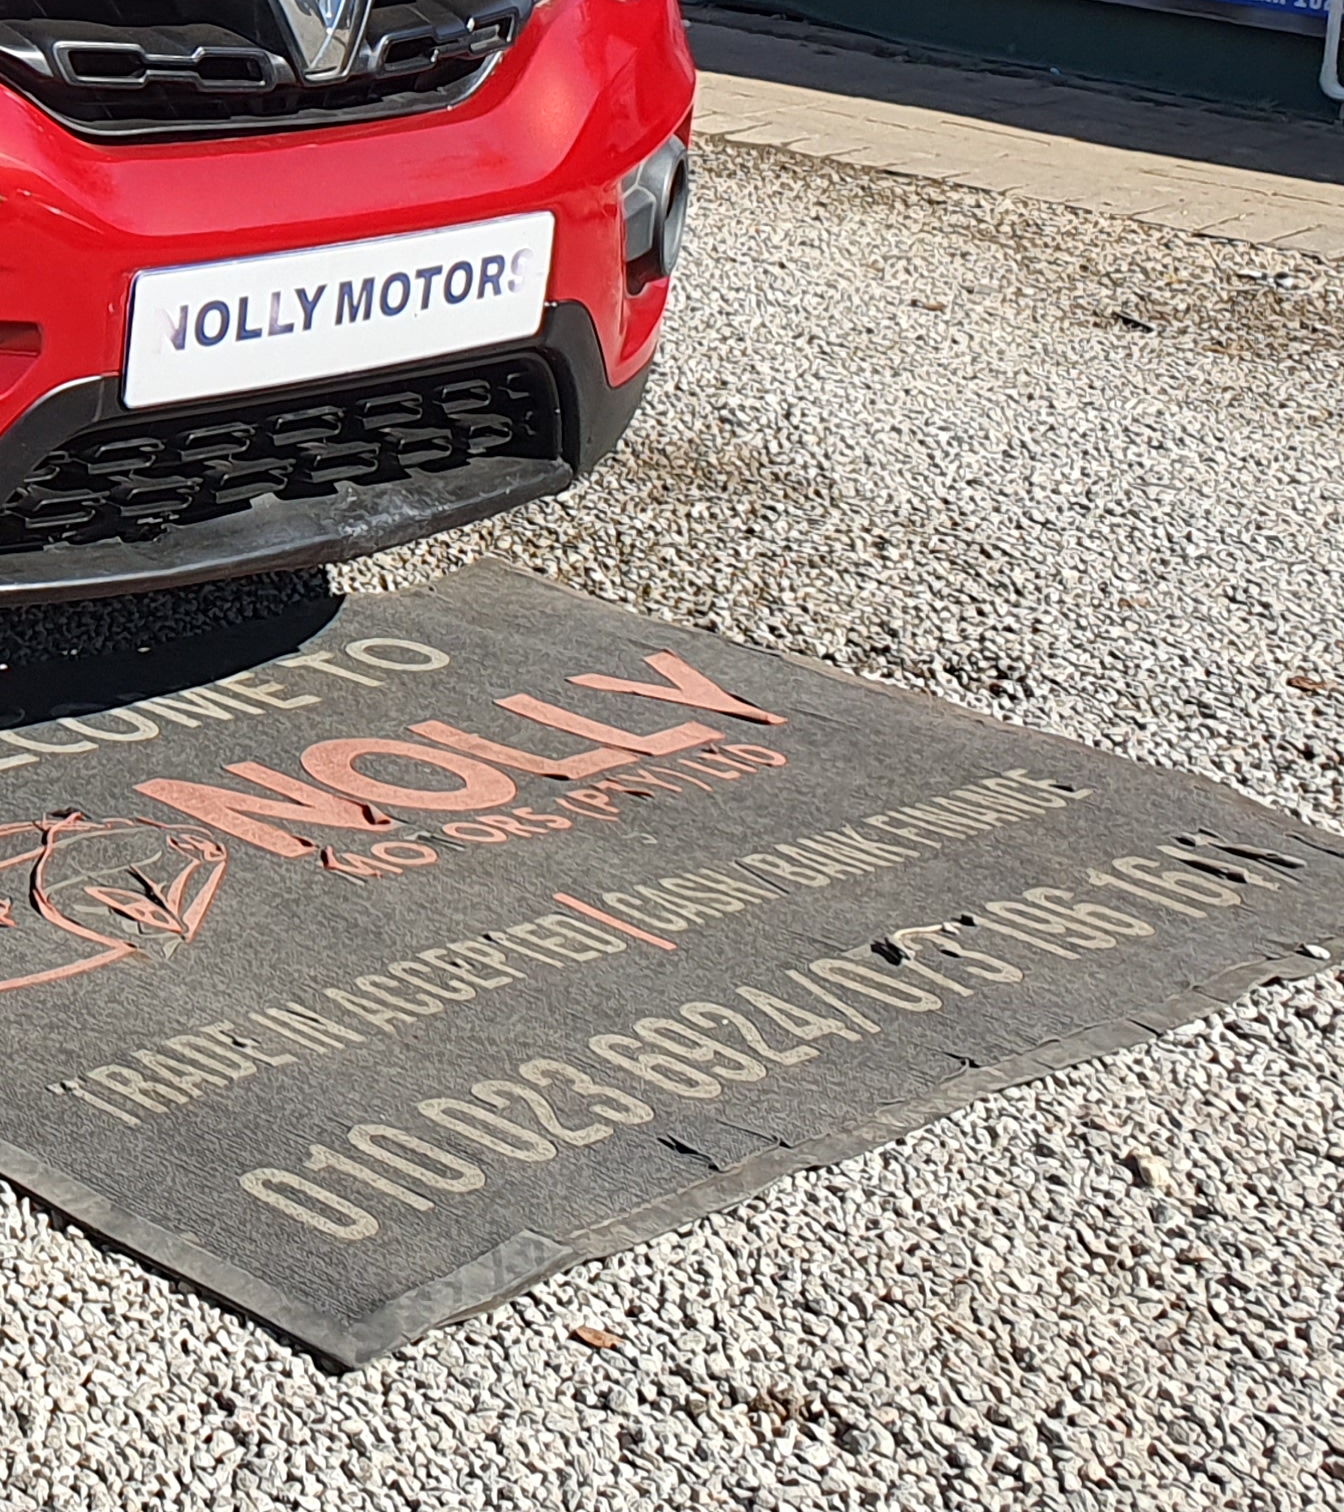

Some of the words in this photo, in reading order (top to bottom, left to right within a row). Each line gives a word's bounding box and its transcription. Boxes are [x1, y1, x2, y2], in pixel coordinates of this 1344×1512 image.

[157, 284, 327, 352] NOLLY
[334, 247, 534, 326] MOTORS
[132, 648, 788, 858] NOLLY
[284, 637, 451, 688] TO
[45, 1020, 300, 1127] TRADE
[247, 1001, 367, 1055] IN
[323, 911, 627, 1035] ACCEPTED
[602, 823, 921, 932] CASH/BANK
[861, 768, 1095, 850] FINANCE
[239, 1122, 487, 1241] 010
[417, 1058, 656, 1163] 023
[964, 887, 1156, 961] 196
